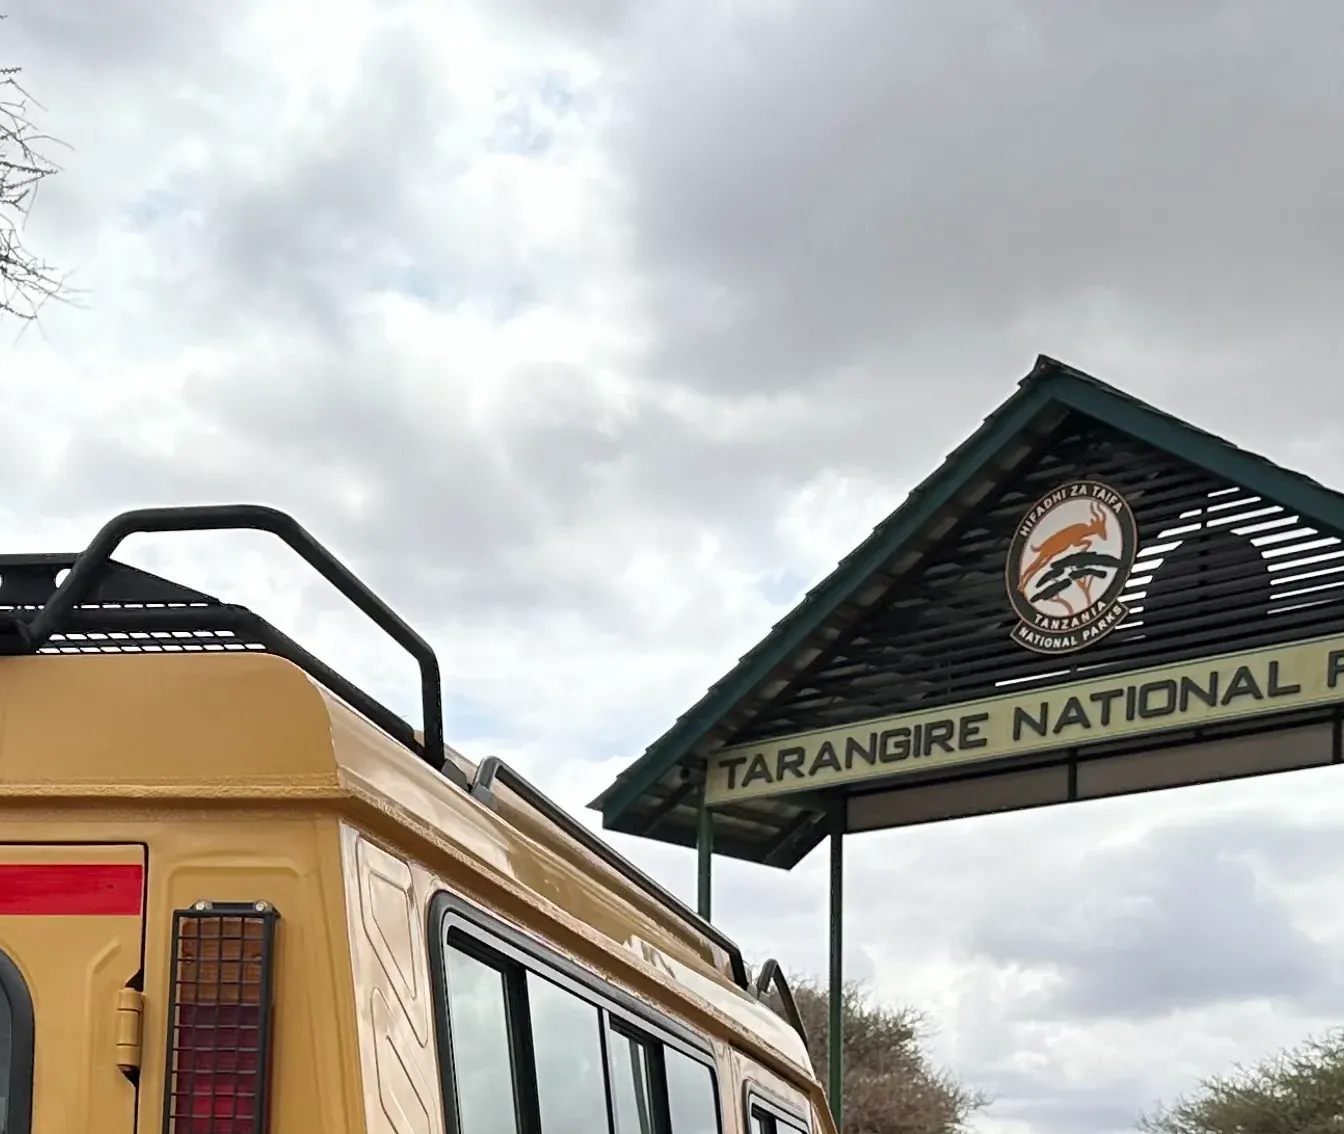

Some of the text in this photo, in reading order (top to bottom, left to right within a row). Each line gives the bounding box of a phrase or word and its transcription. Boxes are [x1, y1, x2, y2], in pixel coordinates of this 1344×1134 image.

[1019, 484, 1123, 537] HIFADHI ZA TAIFA
[1019, 606, 1122, 648] NATIONAL PARKS
[1034, 601, 1107, 630] TANZANIA
[718, 711, 990, 790] TARANGIRE
[1012, 660, 1301, 741] NATIONAL
